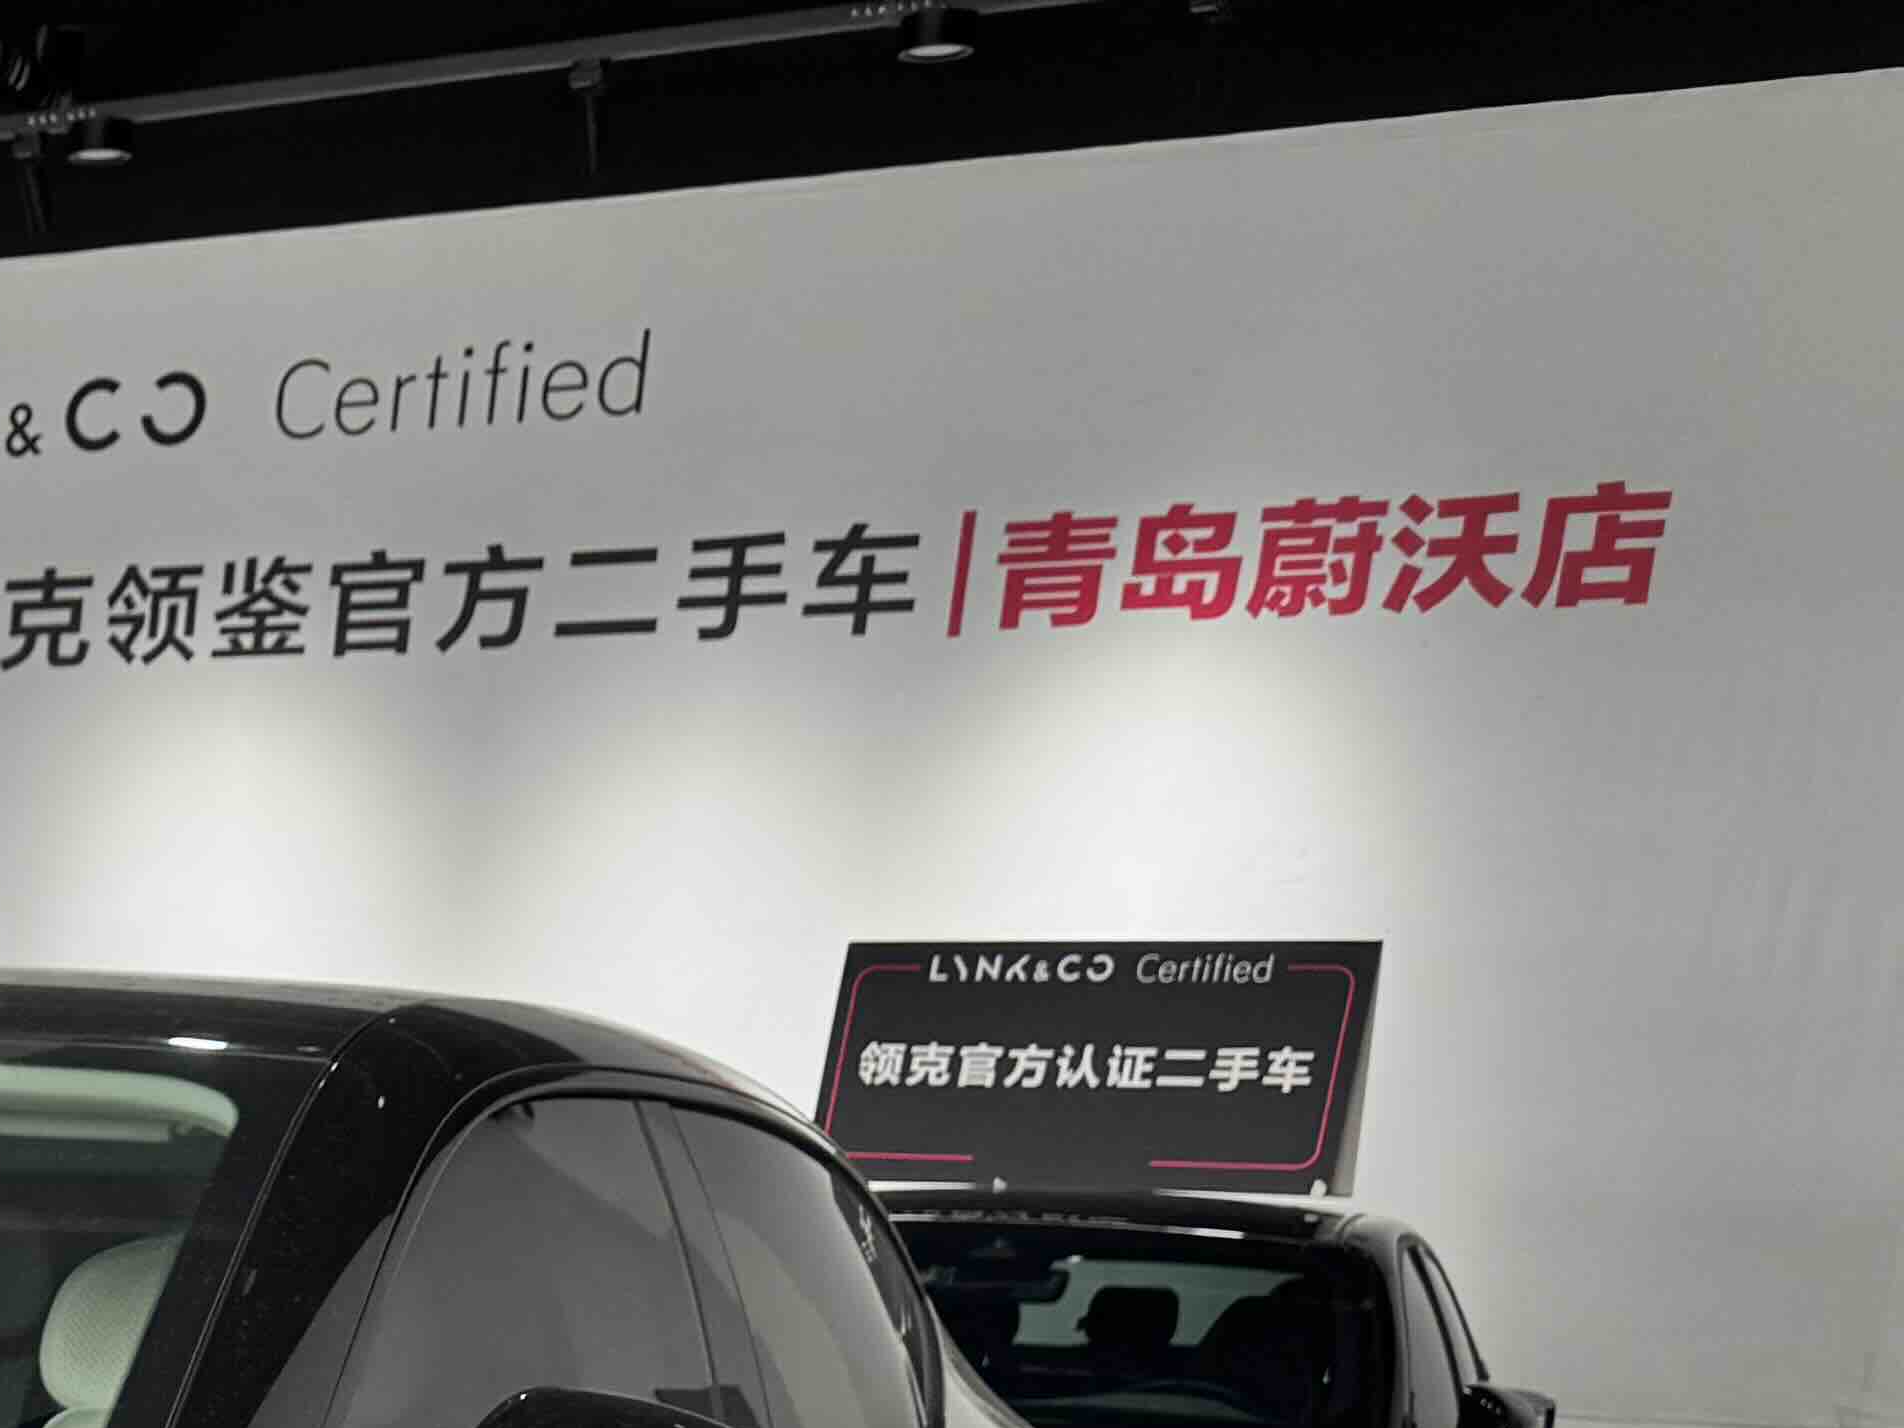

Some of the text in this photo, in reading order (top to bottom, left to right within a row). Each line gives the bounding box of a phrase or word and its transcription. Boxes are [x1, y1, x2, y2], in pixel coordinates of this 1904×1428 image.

[275, 327, 652, 441] Certified
[998, 482, 1673, 631] 青岛蔚沃店
[928, 952, 1274, 984] LYNK&CO Certified
[858, 1040, 1315, 1094] 领克官方认证二手车
